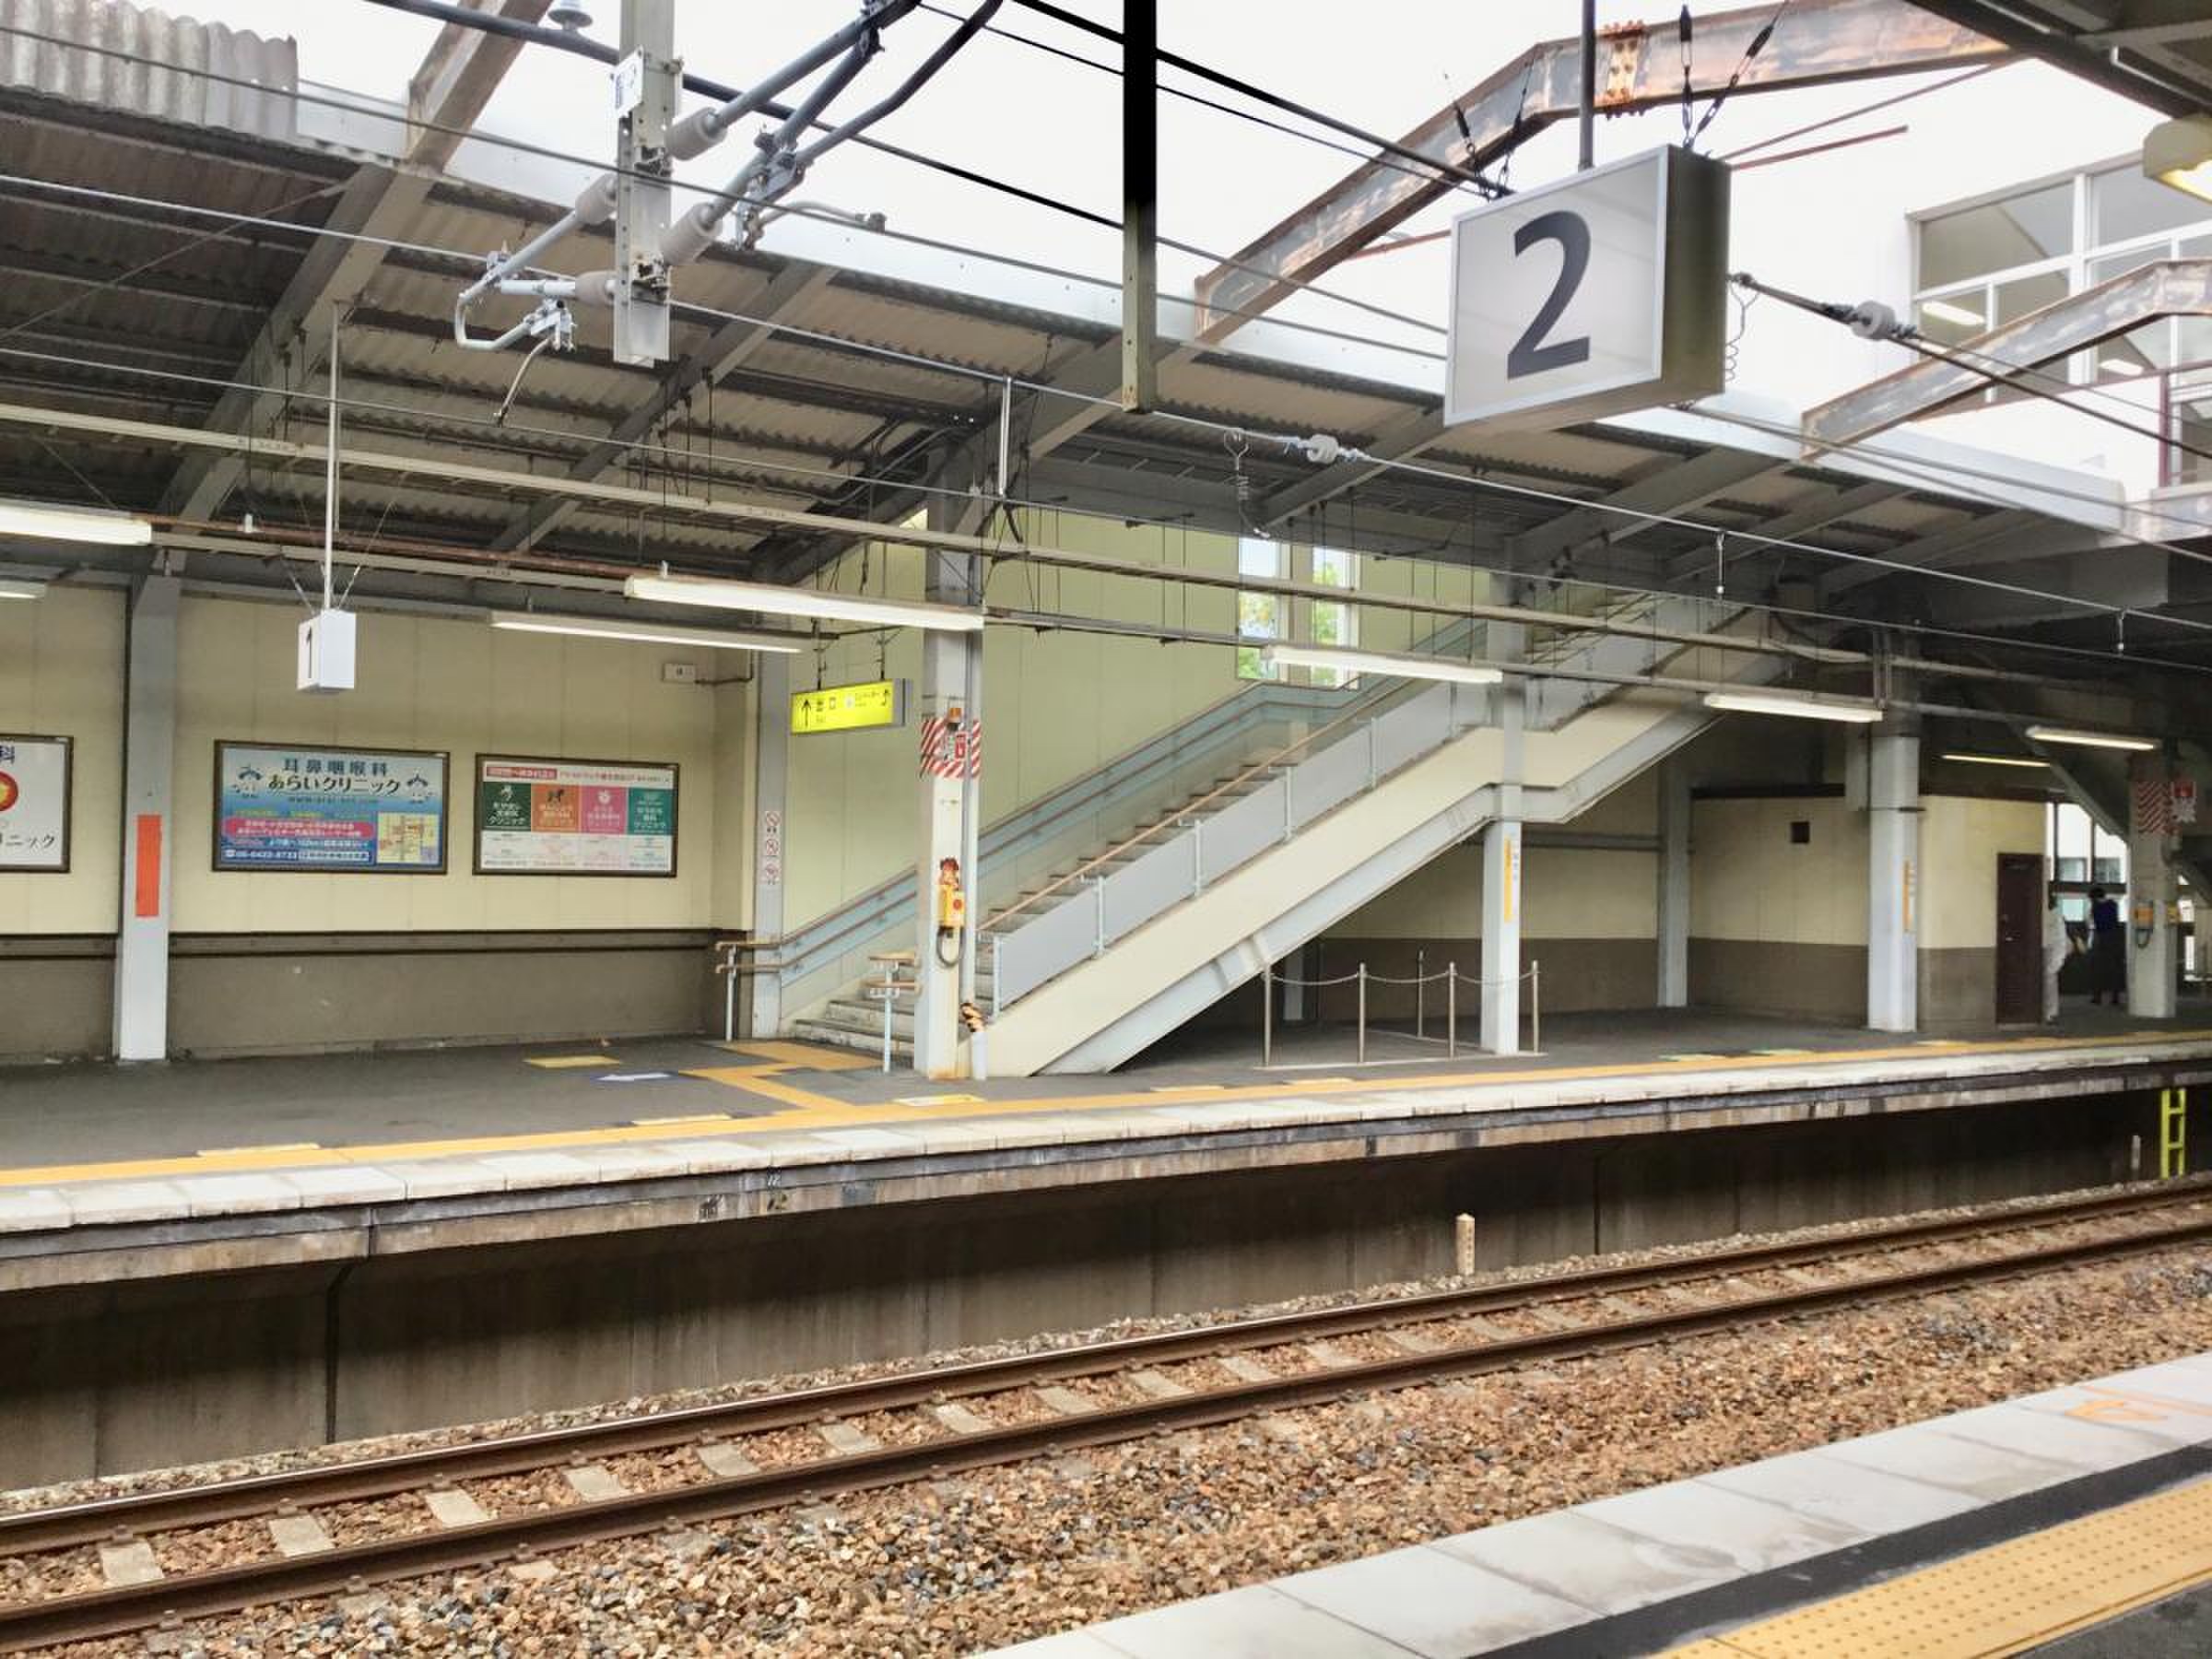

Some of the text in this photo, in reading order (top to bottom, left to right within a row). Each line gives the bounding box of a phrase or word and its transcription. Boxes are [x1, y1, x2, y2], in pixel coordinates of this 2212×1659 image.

[1507, 210, 1592, 382] 2
[284, 758, 388, 777] 耳鼻咽喉科
[268, 773, 401, 795] あらいクリニック
